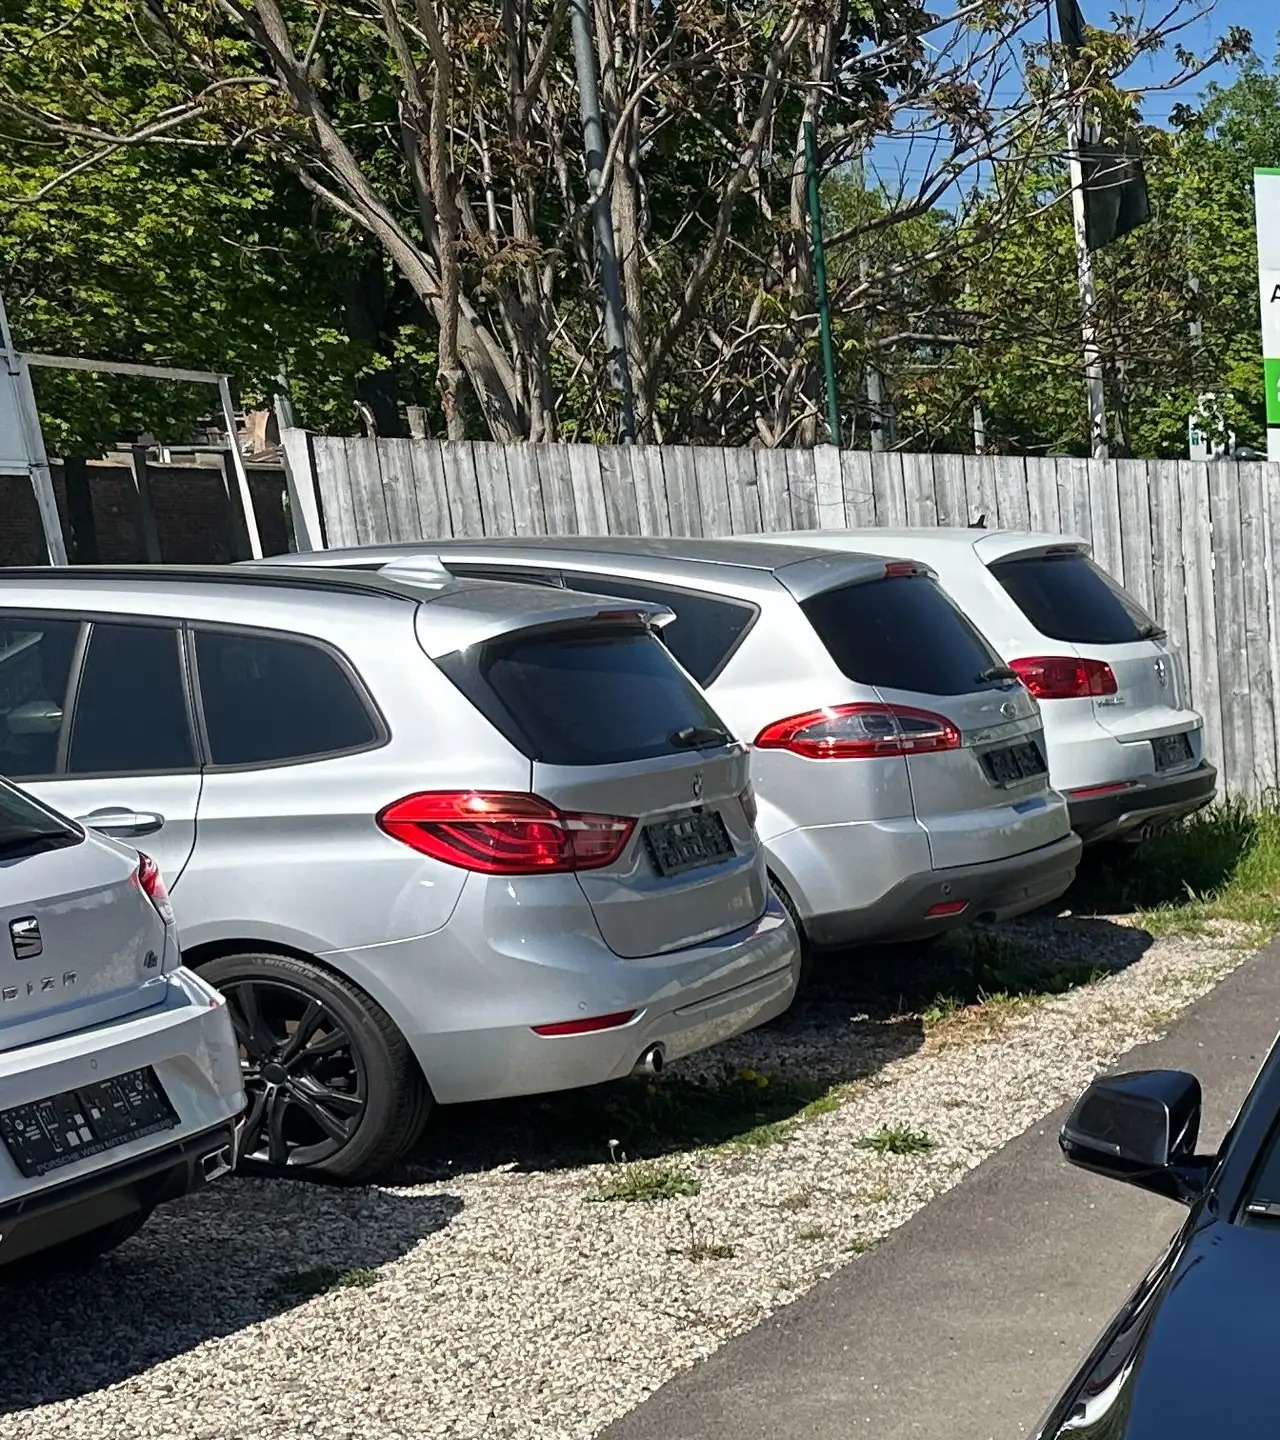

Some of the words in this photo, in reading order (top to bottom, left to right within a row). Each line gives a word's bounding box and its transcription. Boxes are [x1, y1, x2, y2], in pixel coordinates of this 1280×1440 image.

[264, 957, 318, 979] MICHELIN
[36, 1149, 81, 1173] PORSCHE
[82, 1141, 105, 1157] WIEN
